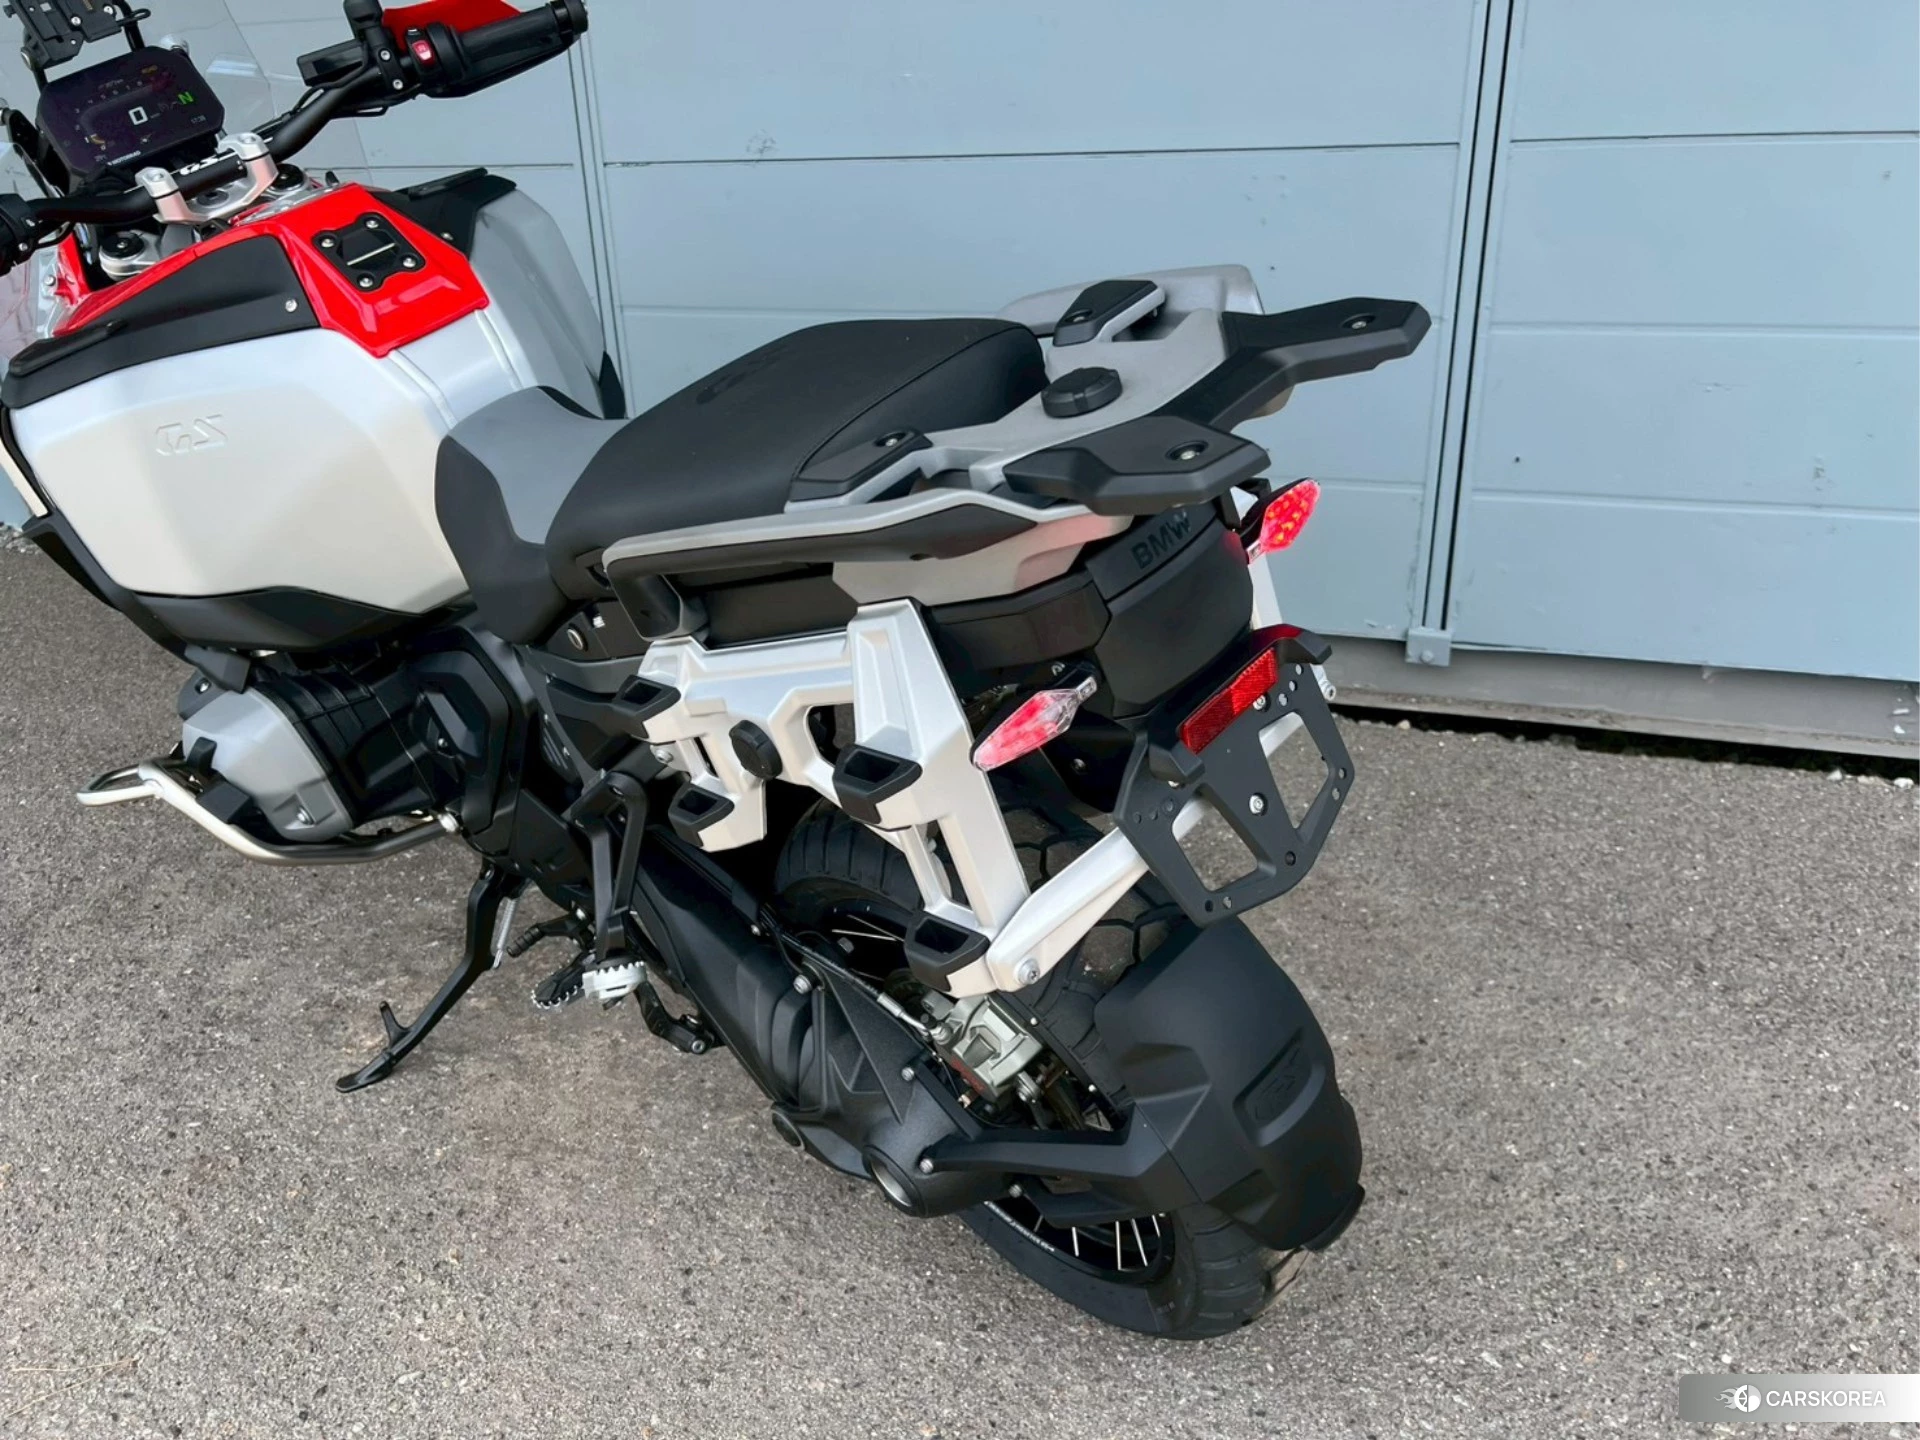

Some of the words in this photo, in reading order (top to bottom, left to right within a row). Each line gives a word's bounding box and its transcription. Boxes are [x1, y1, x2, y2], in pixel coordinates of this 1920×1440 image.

[178, 91, 194, 105] N
[128, 106, 149, 125] 0
[1131, 509, 1192, 570] BMW
